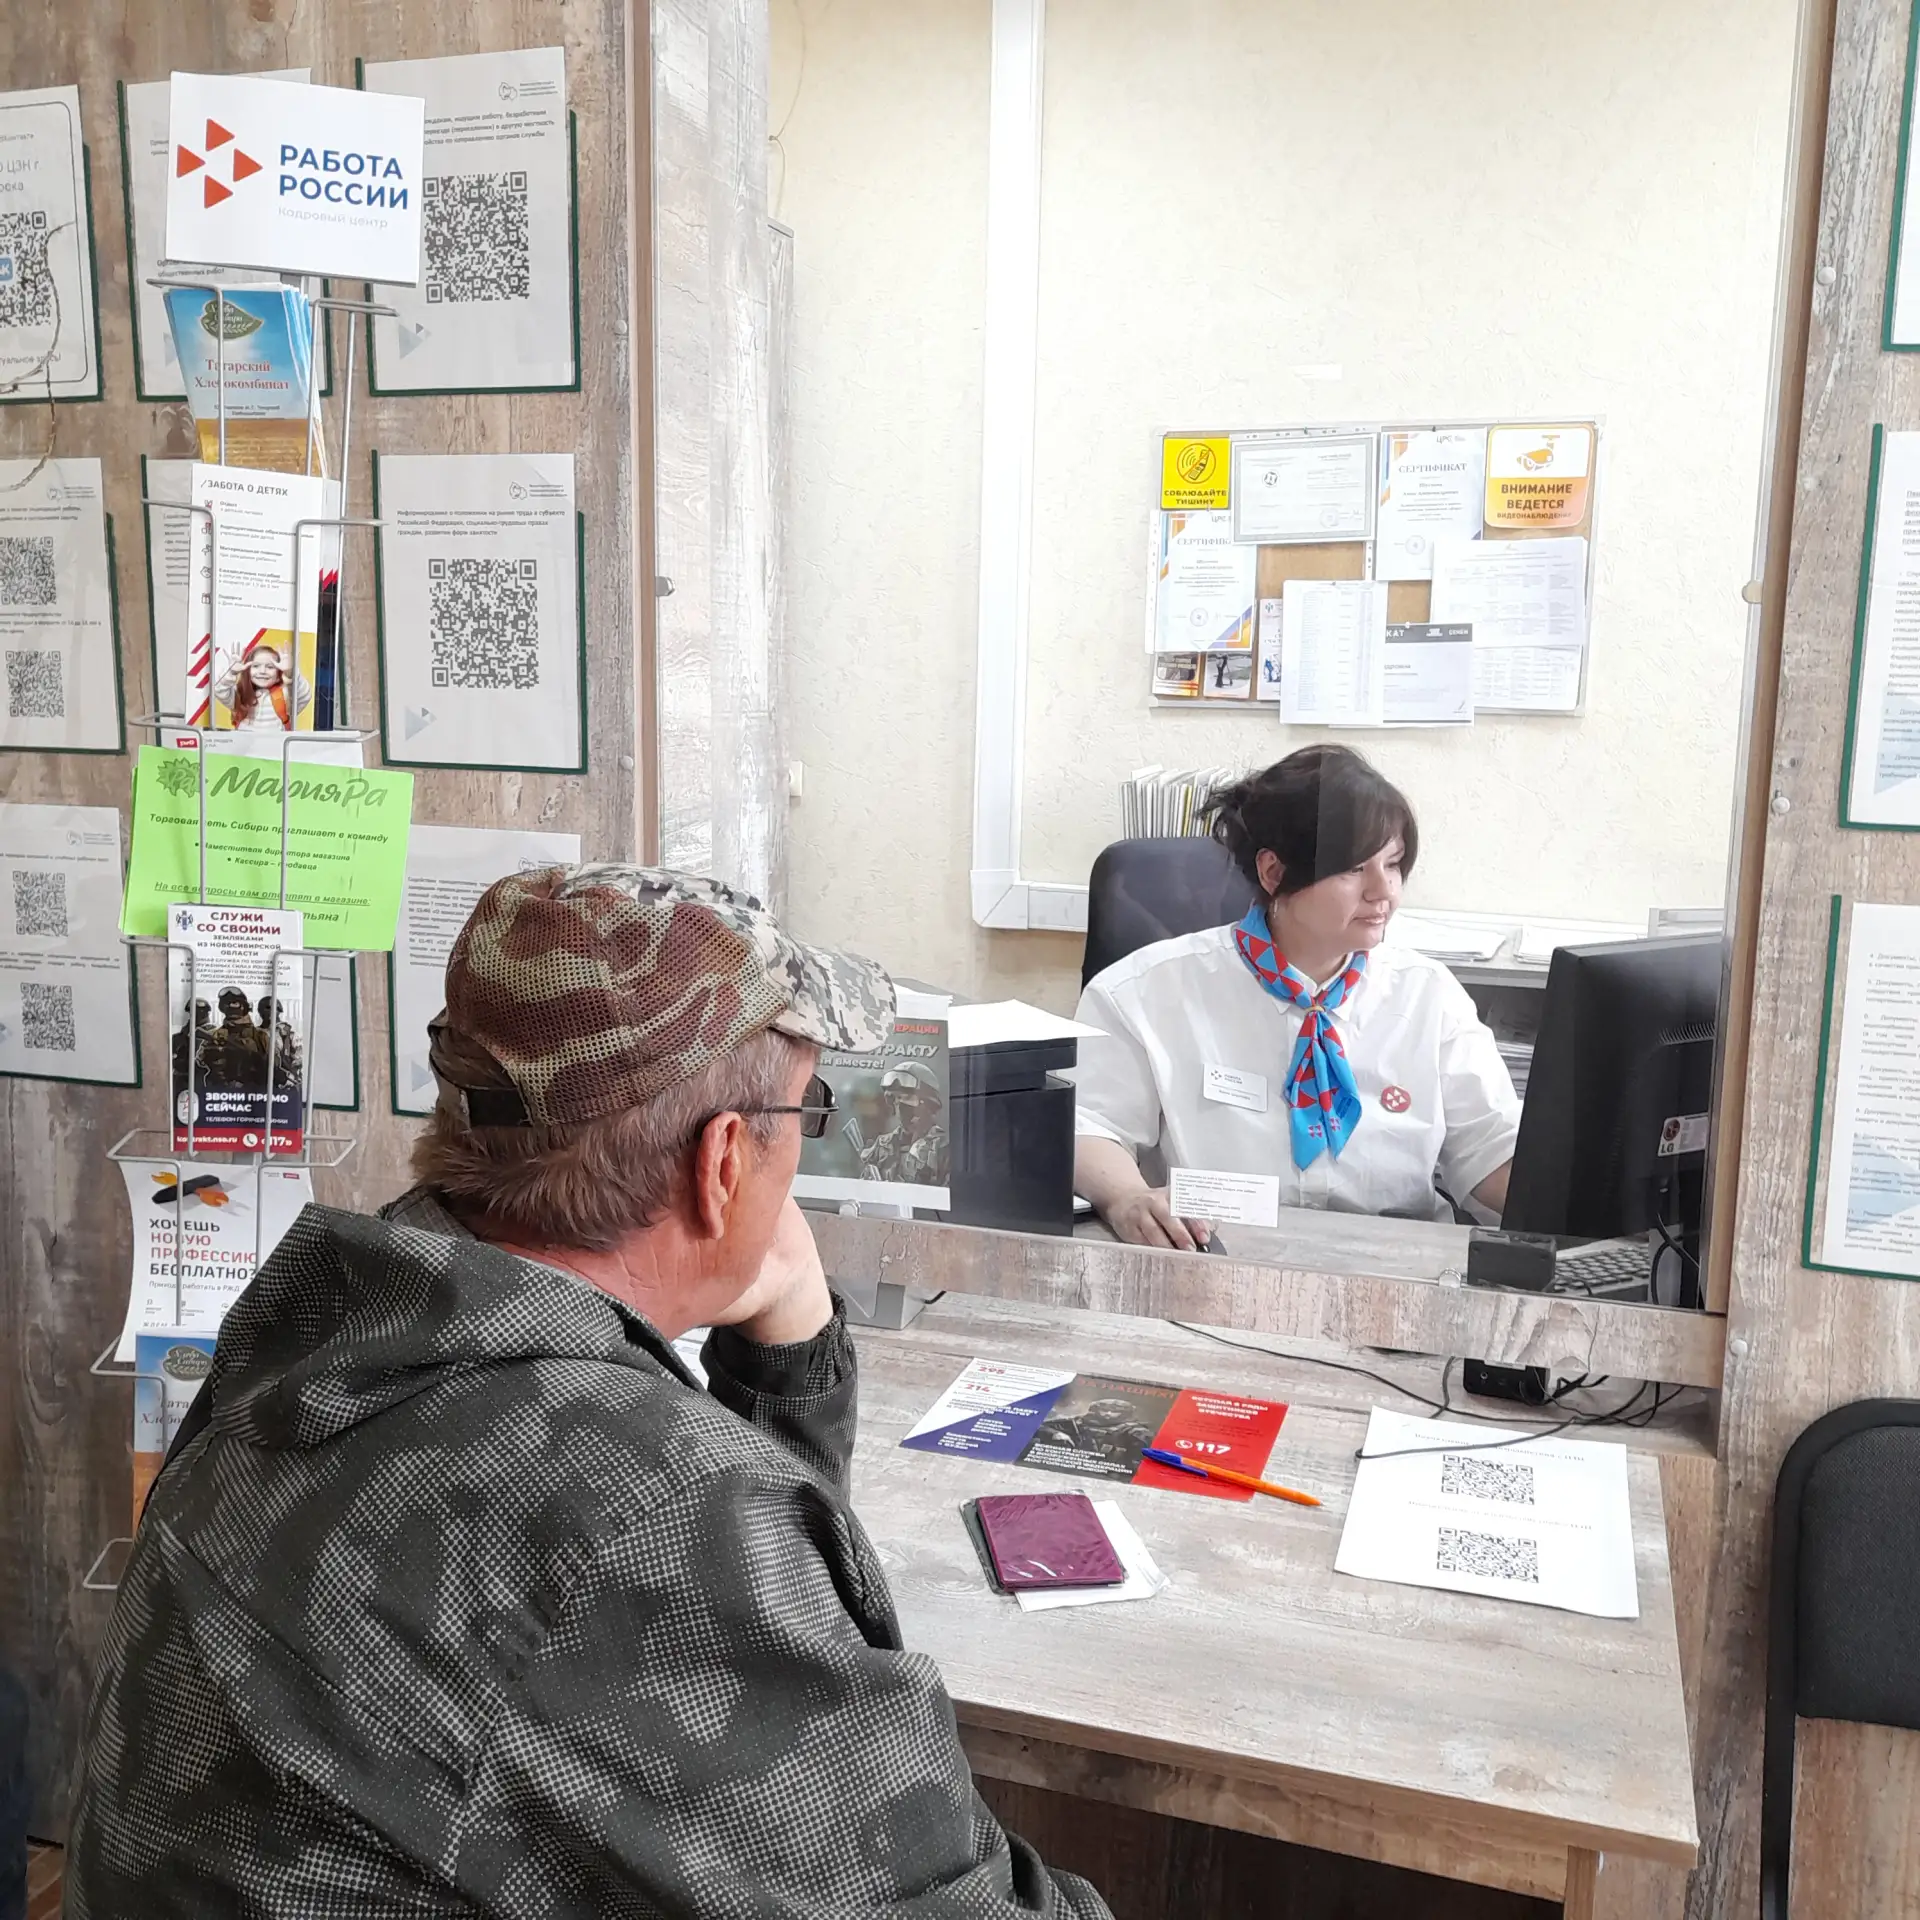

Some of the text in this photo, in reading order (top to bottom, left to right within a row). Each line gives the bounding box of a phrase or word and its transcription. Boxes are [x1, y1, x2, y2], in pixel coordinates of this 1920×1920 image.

[280, 144, 403, 180] РАБОТА
[279, 174, 408, 210] РОССИИ
[349, 216, 388, 230] центр
[194, 376, 289, 390] Хлеокомбинат
[1398, 462, 1468, 474] СЕРТИФИКАТ
[247, 484, 254, 493] О
[256, 485, 288, 497] ДЕТЯХ
[1164, 489, 1227, 497] СОБЛЮДАЙТЕ
[1501, 483, 1573, 494] ВНИМАНИЕ
[1507, 499, 1564, 511] ВЕДЕТСЯ
[149, 813, 199, 827] Торговая
[203, 820, 228, 829] еть
[231, 820, 269, 833] Сибири
[338, 831, 345, 839] в
[347, 832, 389, 844] команду
[312, 852, 351, 862] магазина
[234, 857, 269, 867] Кассира
[277, 861, 317, 871] подавца
[154, 881, 169, 890] На
[261, 892, 312, 902] отвтят
[210, 912, 264, 922] СЛУЖИ
[197, 923, 281, 935] СО СВОИМИ
[210, 942, 281, 951] НОВОСИБИРСКОЙ
[868, 1043, 939, 1058] ТРАКТУ
[835, 1058, 885, 1070] вместе!
[205, 1092, 245, 1101] ЗВОНИ
[205, 1102, 252, 1112] СЕЙЧАС
[176, 1135, 238, 1145] korakt.nso.ru
[1661, 1143, 1674, 1154] LG
[150, 1262, 257, 1281] БЕСПЛАТНО?
[149, 1280, 177, 1289] Приход
[182, 1281, 216, 1291] работать
[222, 1285, 240, 1293] РЖД
[1191, 1395, 1233, 1406] ВСТУПАЙ
[1241, 1403, 1269, 1412] РЯДЫ
[1196, 1402, 1259, 1416] ЗАЩИТНИКОВ
[1198, 1408, 1251, 1420] ОТЕЧЕСТВА
[1034, 1442, 1106, 1457] ВОЕННАЯ СЛУЖБА
[1044, 1448, 1091, 1459] КОНТРАКТУ
[1195, 1441, 1231, 1454] 117
[1024, 1457, 1076, 1470] ДОСТОЙНЫЙ
[1027, 1453, 1083, 1466] РОССИЙСКОЙ
[1036, 1451, 1098, 1464] ВООРУЖЕННЫХ
[1098, 1459, 1126, 1469] СИЛАХ
